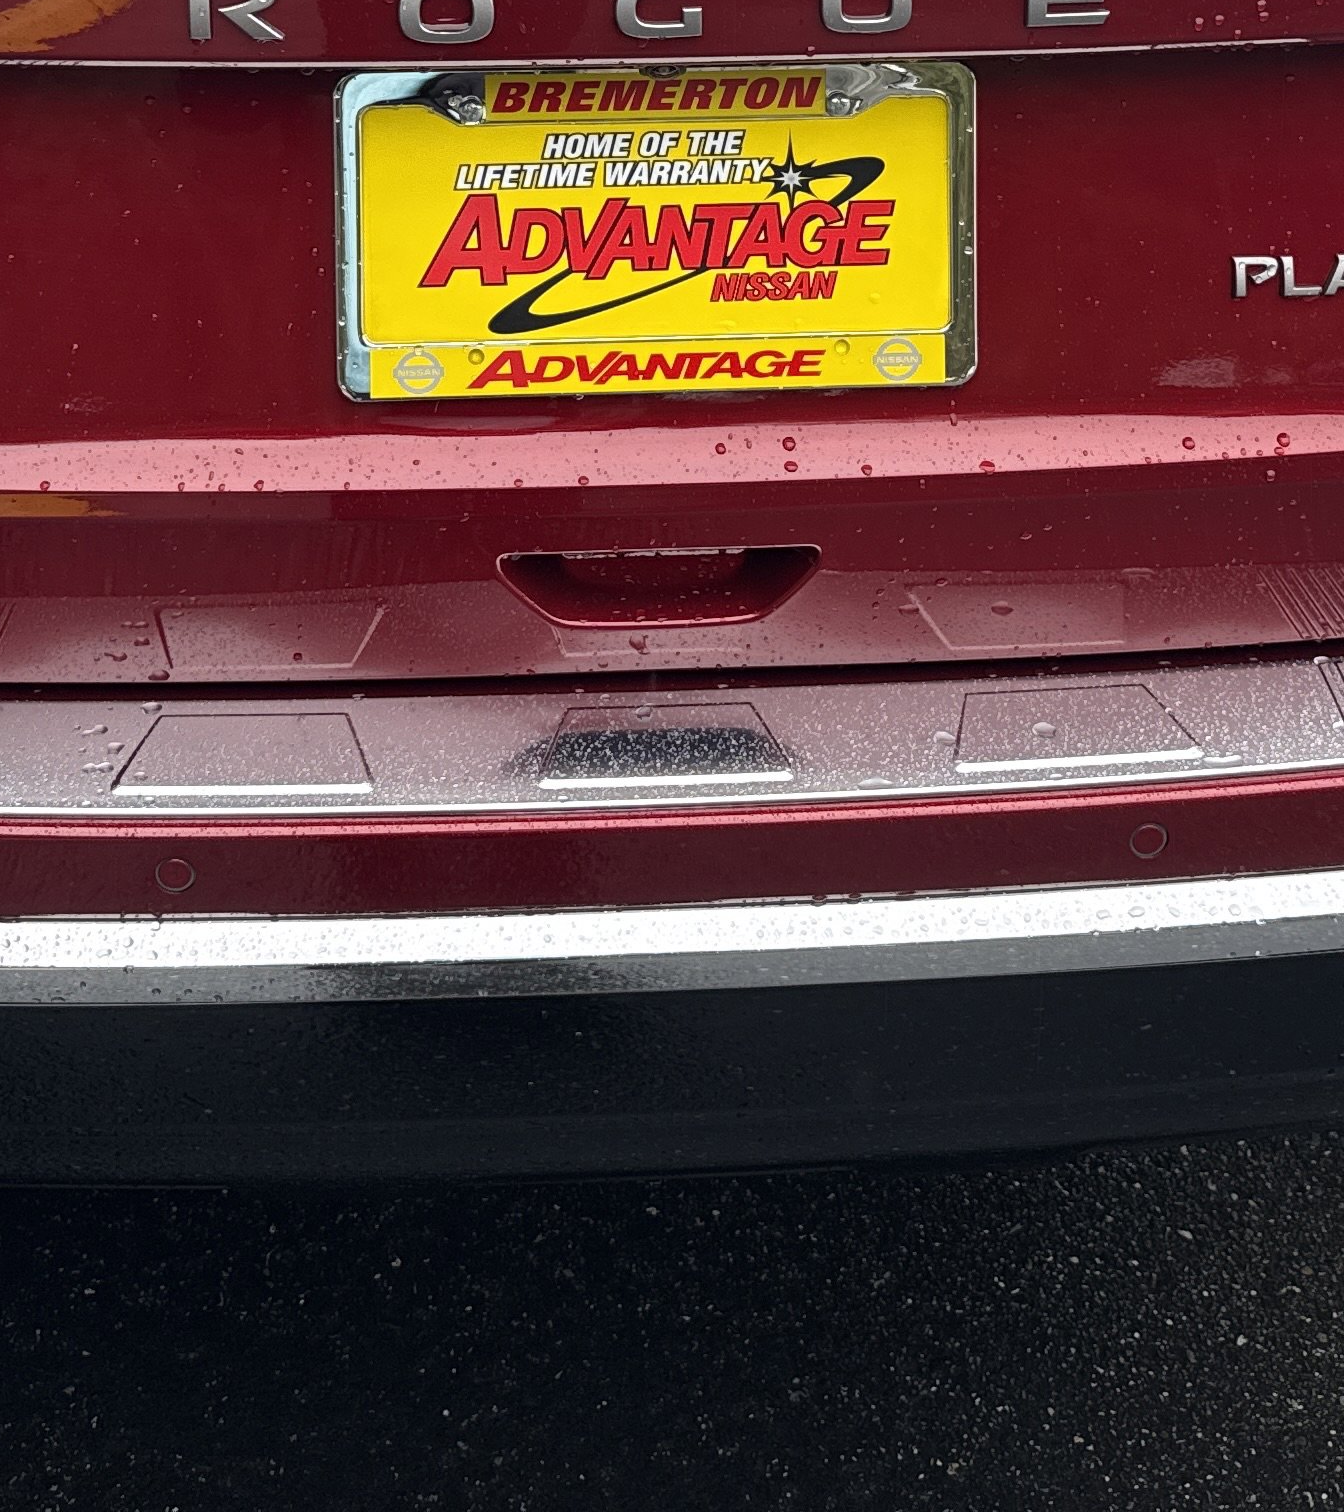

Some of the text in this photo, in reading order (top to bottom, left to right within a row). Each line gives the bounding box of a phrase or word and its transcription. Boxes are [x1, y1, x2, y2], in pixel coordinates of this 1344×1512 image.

[491, 76, 822, 114] BREMERTON
[541, 129, 746, 160] HOME OF THE
[453, 157, 773, 191] LIFETIME WARRANTY
[417, 193, 896, 288] ADVANTAGE
[710, 271, 838, 302] NISSAN
[397, 368, 441, 377] NISSAN
[466, 349, 827, 389] ADVANTAGE
[876, 355, 918, 364] NISSAN
